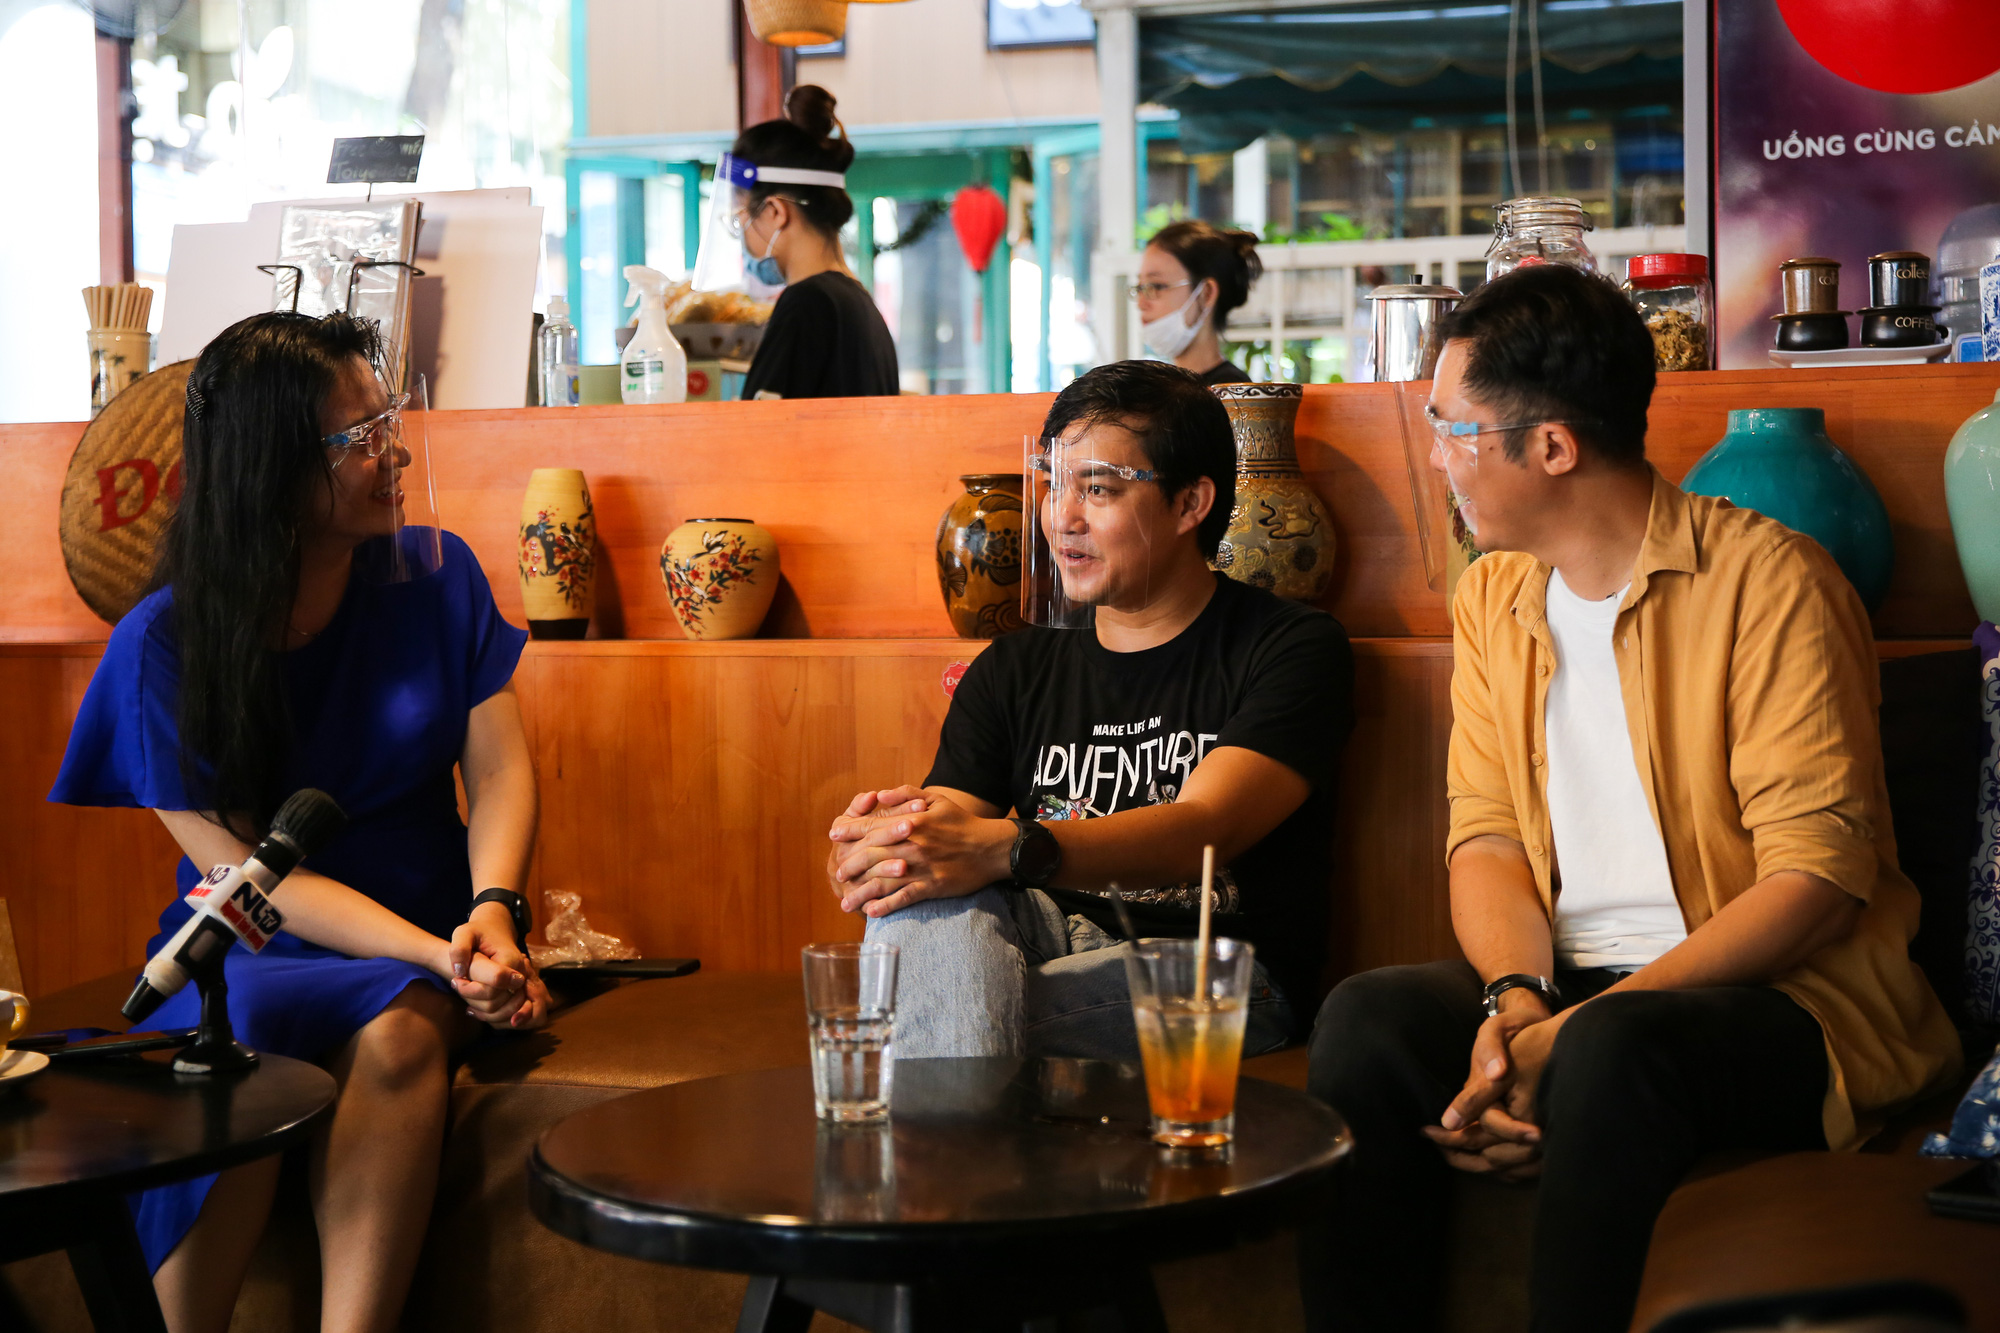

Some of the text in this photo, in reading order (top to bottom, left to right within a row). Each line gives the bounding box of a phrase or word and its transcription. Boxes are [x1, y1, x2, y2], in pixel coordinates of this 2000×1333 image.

[1763, 129, 1846, 161] UỐNG
[1854, 127, 1936, 154] CÙNG
[1092, 724, 1125, 736] MAKE
[1148, 715, 1162, 730] AN
